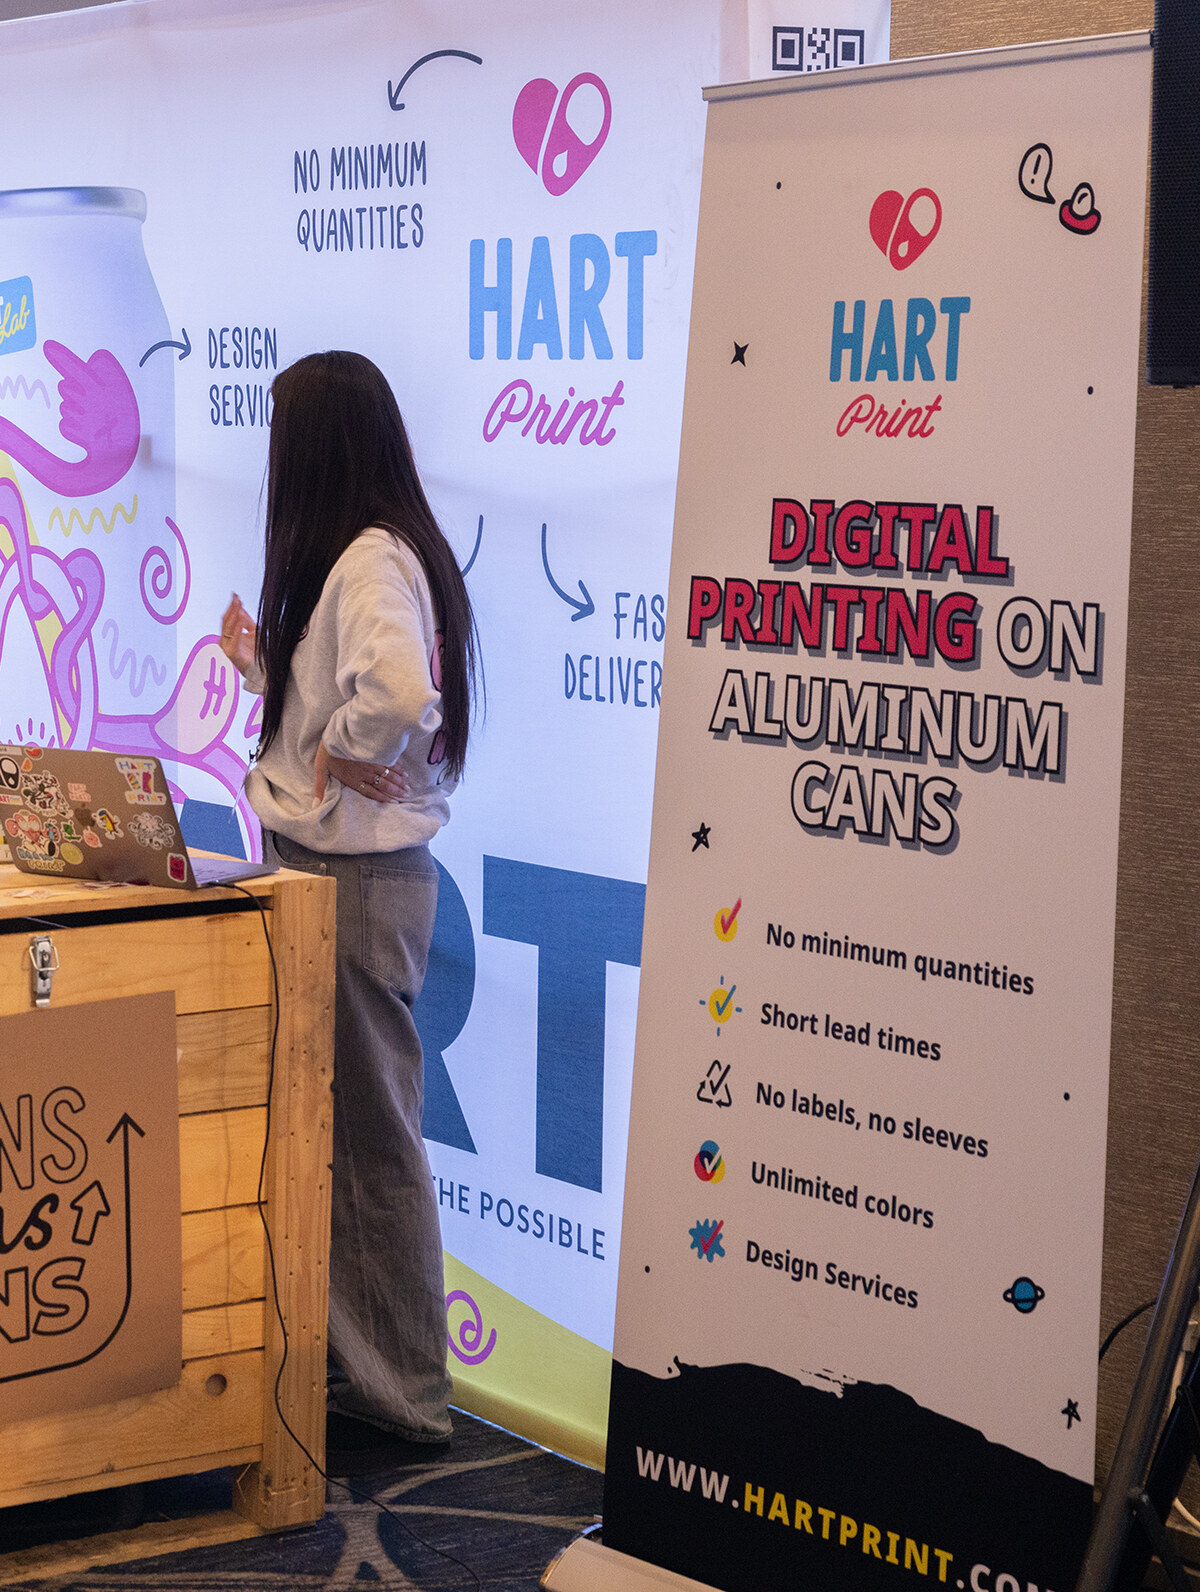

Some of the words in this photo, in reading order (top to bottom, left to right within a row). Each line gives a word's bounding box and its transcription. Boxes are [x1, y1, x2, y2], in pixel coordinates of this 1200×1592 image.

[294, 148, 320, 194] NO
[330, 140, 427, 191] MINIMUM
[297, 203, 424, 252] QUANTITIES
[469, 230, 658, 361] HART
[208, 326, 277, 370] DESIGN
[829, 296, 971, 382] HART
[482, 378, 625, 446] Print
[836, 393, 942, 438] Print
[769, 498, 1011, 583] DIGITAL
[613, 592, 666, 643] FAS
[687, 576, 980, 669] PRINTING
[997, 597, 1103, 680] ON
[564, 652, 663, 709] DELIVER
[709, 669, 1065, 777] ALUMINUM
[791, 760, 960, 851] CANS
[766, 923, 795, 949] No
[801, 931, 908, 970] minimum
[913, 954, 1035, 995] quantities
[760, 1003, 818, 1035] Short
[824, 1014, 871, 1047] lead
[877, 1027, 942, 1061] times
[756, 1082, 785, 1108] No
[792, 1088, 862, 1130] labels,
[868, 1109, 897, 1135] no
[903, 1117, 989, 1158] sleeves
[433, 1176, 470, 1215] HE
[480, 1191, 605, 1261] POSSIBLE
[751, 1162, 859, 1209] Unlimited
[864, 1192, 935, 1229] colors
[746, 1240, 818, 1282] Design
[825, 1262, 919, 1309] Services
